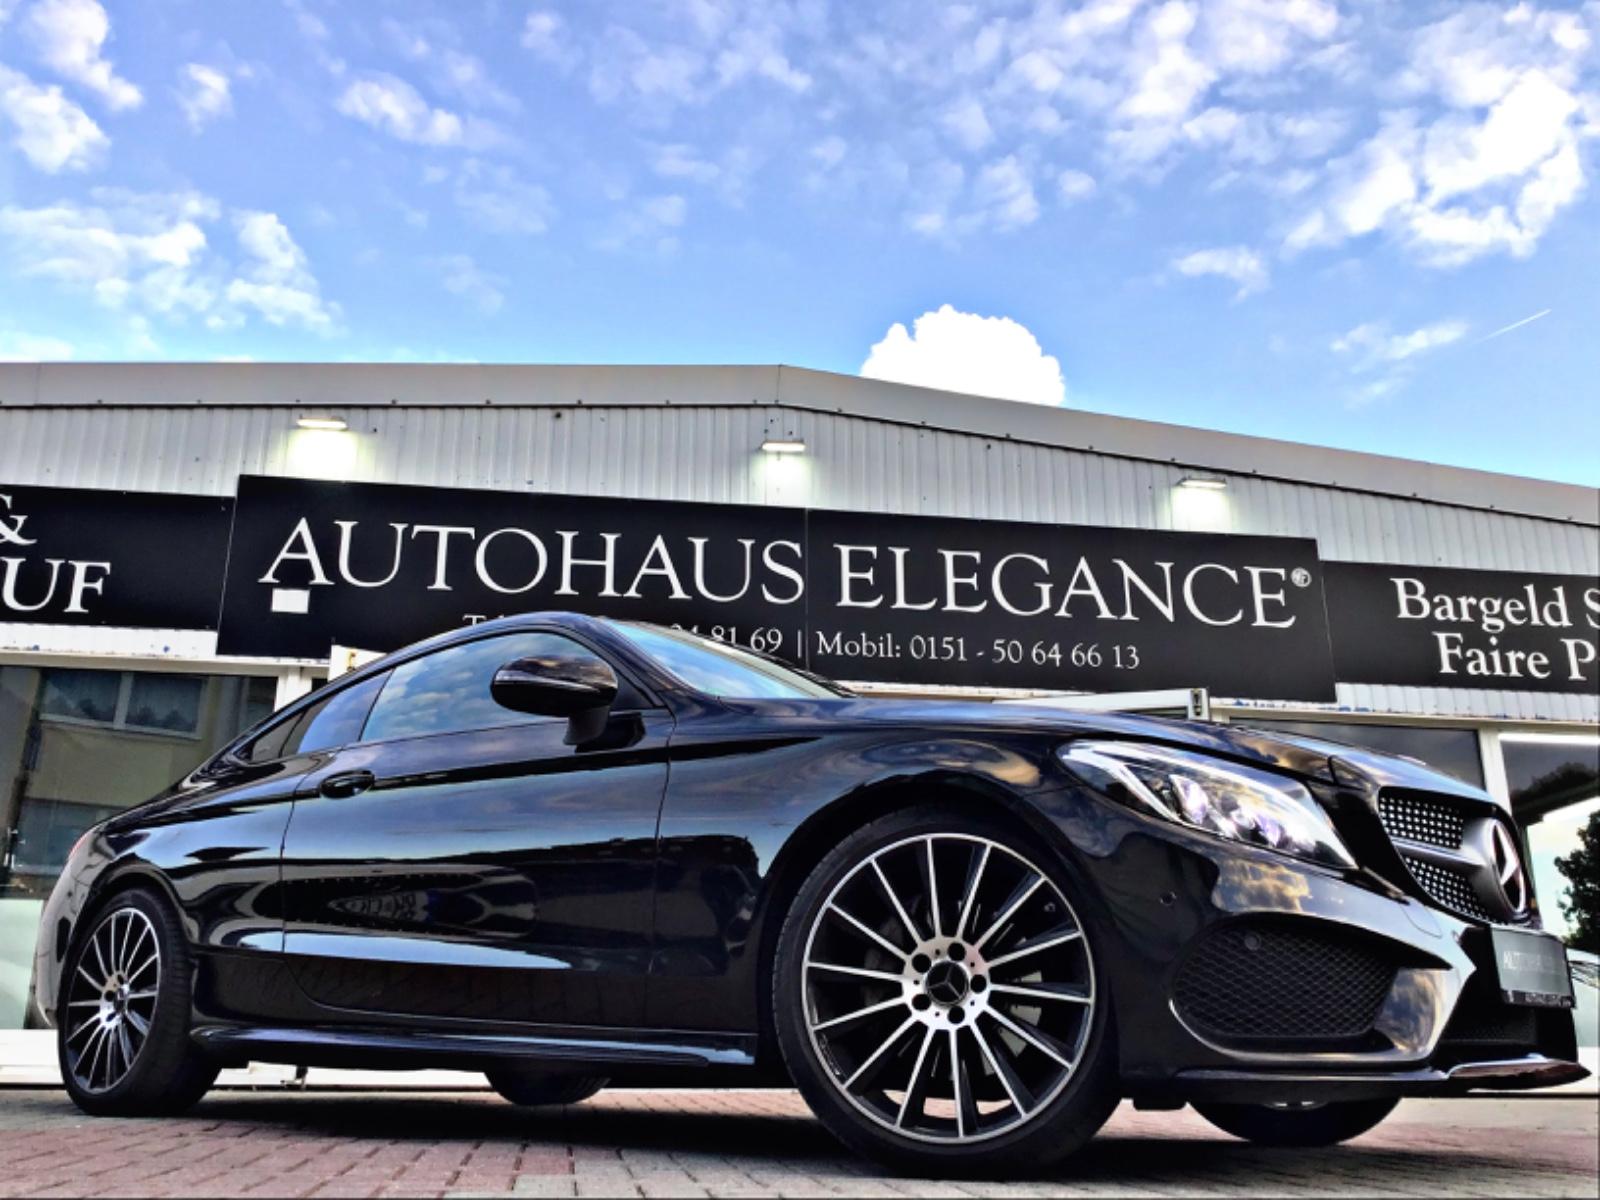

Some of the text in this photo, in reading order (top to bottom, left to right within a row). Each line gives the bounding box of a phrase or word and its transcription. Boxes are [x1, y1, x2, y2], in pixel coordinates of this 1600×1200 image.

[0, 557, 111, 613] UF
[258, 516, 805, 605] AUTOHAUS
[1389, 577, 1573, 633] Bargeld
[750, 627, 783, 653] 69
[815, 630, 902, 658] Mobil:
[909, 635, 968, 661] 0151
[992, 639, 1023, 664] 50
[1031, 640, 1062, 668] 64
[1071, 643, 1102, 668] 66
[1112, 645, 1140, 669] 13
[1432, 630, 1596, 681] Faire P
